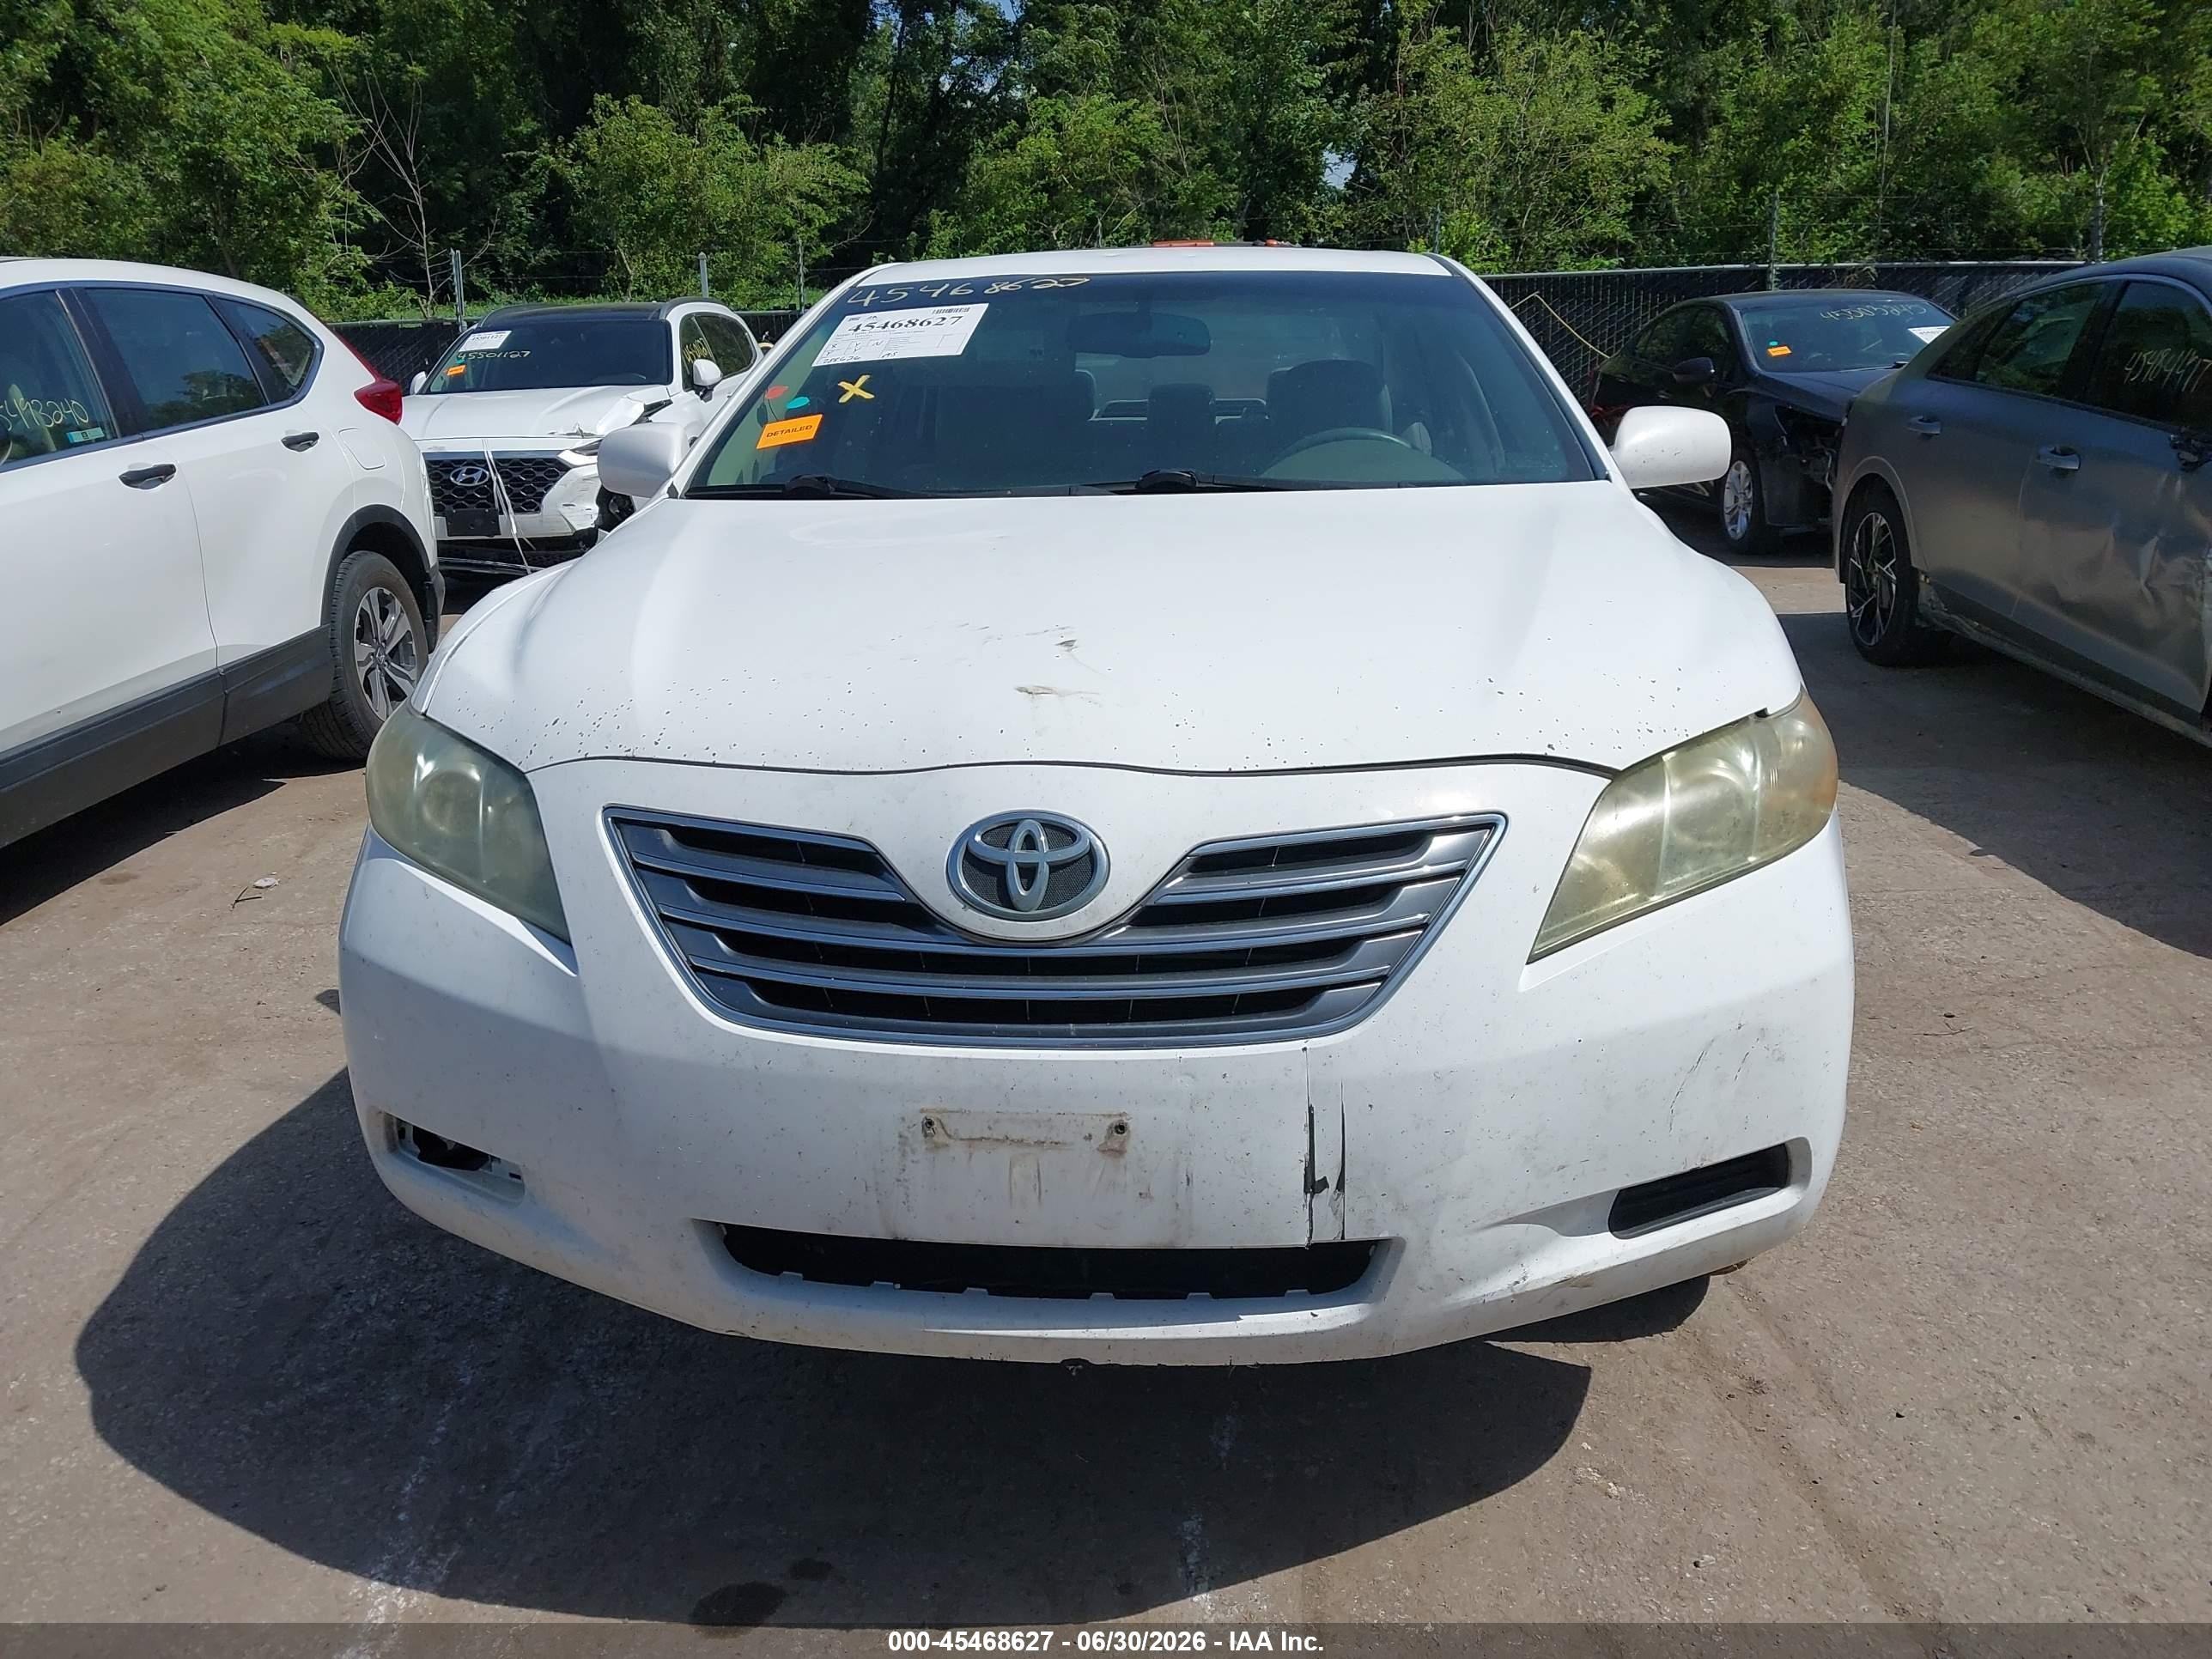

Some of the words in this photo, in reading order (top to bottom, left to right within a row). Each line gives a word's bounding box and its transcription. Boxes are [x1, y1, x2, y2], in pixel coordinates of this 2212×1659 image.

[848, 277, 1090, 307] 45468627
[848, 315, 963, 333] 45468627
[457, 350, 532, 360] 45501127
[766, 424, 813, 438] DETAILED
